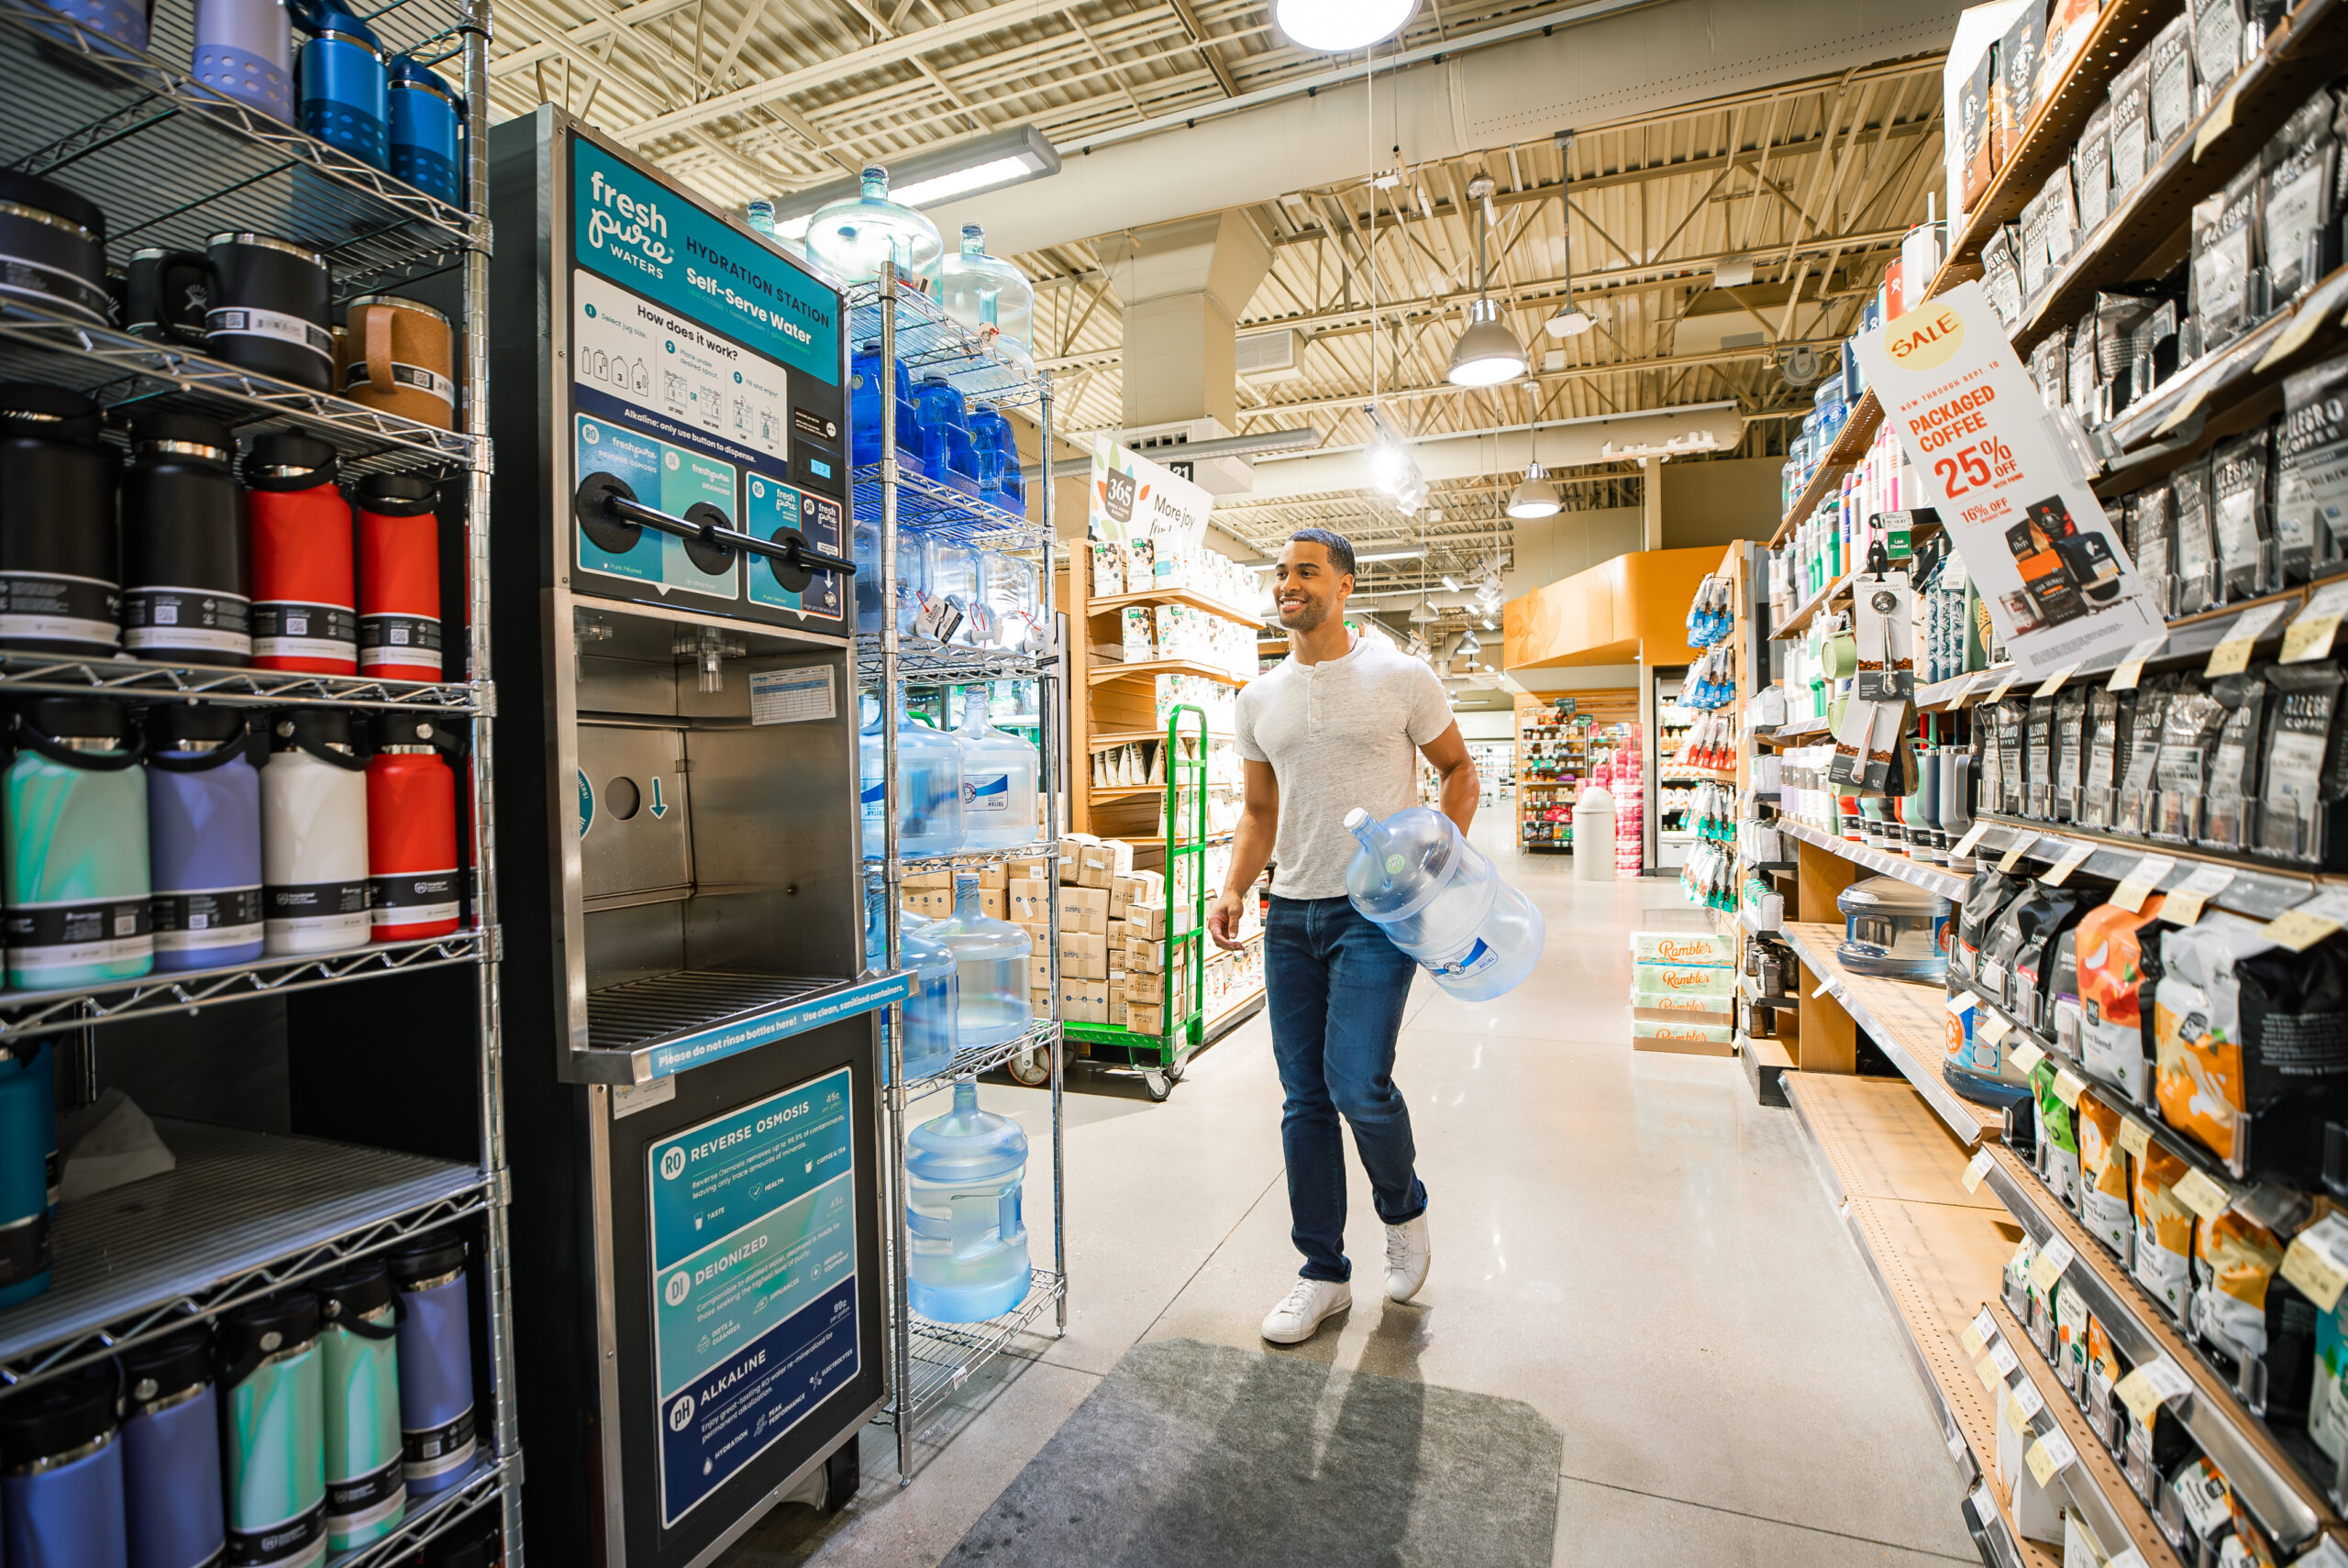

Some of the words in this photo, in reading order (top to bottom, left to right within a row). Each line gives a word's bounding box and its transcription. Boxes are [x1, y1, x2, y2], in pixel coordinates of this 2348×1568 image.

[591, 171, 667, 238] fresh
[588, 208, 673, 264] pure
[610, 243, 663, 280] WATERS
[686, 236, 772, 296] HYDRATION
[776, 288, 830, 328] STATION
[686, 267, 767, 322] Self-Serve
[770, 310, 812, 346] Water
[601, 314, 621, 327] Select
[622, 321, 634, 334] jug
[637, 304, 663, 326] How
[667, 320, 693, 340] does
[696, 332, 705, 347] it
[706, 340, 738, 361] work?
[1891, 312, 1959, 358] SALE
[617, 373, 623, 381] 3
[1900, 399, 1919, 413] NOW
[1922, 380, 1960, 402] THROUGH
[1909, 385, 1996, 436] PACKAGED
[585, 428, 597, 441] RO
[624, 408, 659, 429] Alkaline:
[660, 421, 677, 437] only
[678, 428, 692, 440] use
[692, 433, 715, 447] button
[716, 443, 724, 452] to
[725, 446, 757, 463] dispense.
[1919, 411, 1988, 453] COFFEE
[1933, 436, 2012, 500] 25%
[1994, 459, 2017, 477] OFF
[754, 483, 762, 495] RO
[777, 488, 796, 502] fresh
[1108, 479, 1132, 507] 365
[1992, 479, 2008, 490] WITH
[776, 499, 797, 512] pure
[818, 502, 836, 516] fresh
[818, 513, 837, 525] pure
[1154, 494, 1180, 521] More
[1180, 507, 1196, 532] joy
[1960, 503, 1989, 524] 16%
[1990, 497, 2009, 512] OFF
[927, 603, 938, 618] GALLON
[1659, 940, 1713, 961] Rambler
[1663, 971, 1710, 988] Rambler
[659, 1050, 692, 1067] Please
[692, 1044, 705, 1056] do
[706, 1039, 723, 1054] not
[723, 1033, 745, 1048] rinse
[747, 1024, 775, 1042] bottles
[777, 1016, 796, 1032] here!
[803, 1011, 816, 1023] Use
[817, 1004, 839, 1020] clean,
[840, 993, 869, 1010] sanitized
[870, 984, 904, 1002] containers.
[691, 1125, 752, 1162] REVERSE
[756, 1101, 810, 1133] OSMOSIS
[665, 1153, 681, 1175] RO
[692, 1172, 718, 1189] Reverse
[746, 1149, 771, 1165] removes
[771, 1144, 780, 1155] up
[692, 1183, 716, 1200] leaving
[717, 1178, 731, 1190] only
[732, 1169, 748, 1181] trace
[748, 1157, 776, 1174] amounts
[775, 1154, 781, 1162] of
[764, 1177, 784, 1192] HEALTH
[706, 1207, 725, 1220] TASTE
[695, 1235, 768, 1285] DEIONIZED
[671, 1277, 683, 1300] DI
[696, 1284, 737, 1312] Comparable
[737, 1279, 745, 1287] to
[697, 1309, 715, 1323] those
[716, 1293, 741, 1311] seeking
[822, 1348, 853, 1376] ELECTROLYTES
[700, 1349, 767, 1407] ALKALINE
[702, 1418, 720, 1433] Enjoy
[720, 1381, 761, 1421] great-tasting
[760, 1376, 770, 1388] RO
[770, 1366, 787, 1381] water
[825, 1331, 834, 1341] for
[675, 1399, 690, 1430] pH
[769, 1393, 805, 1426] PERFORMANCE
[769, 1403, 782, 1418] PEAK
[702, 1413, 738, 1445] permanent
[714, 1430, 748, 1460] HYDRATION
